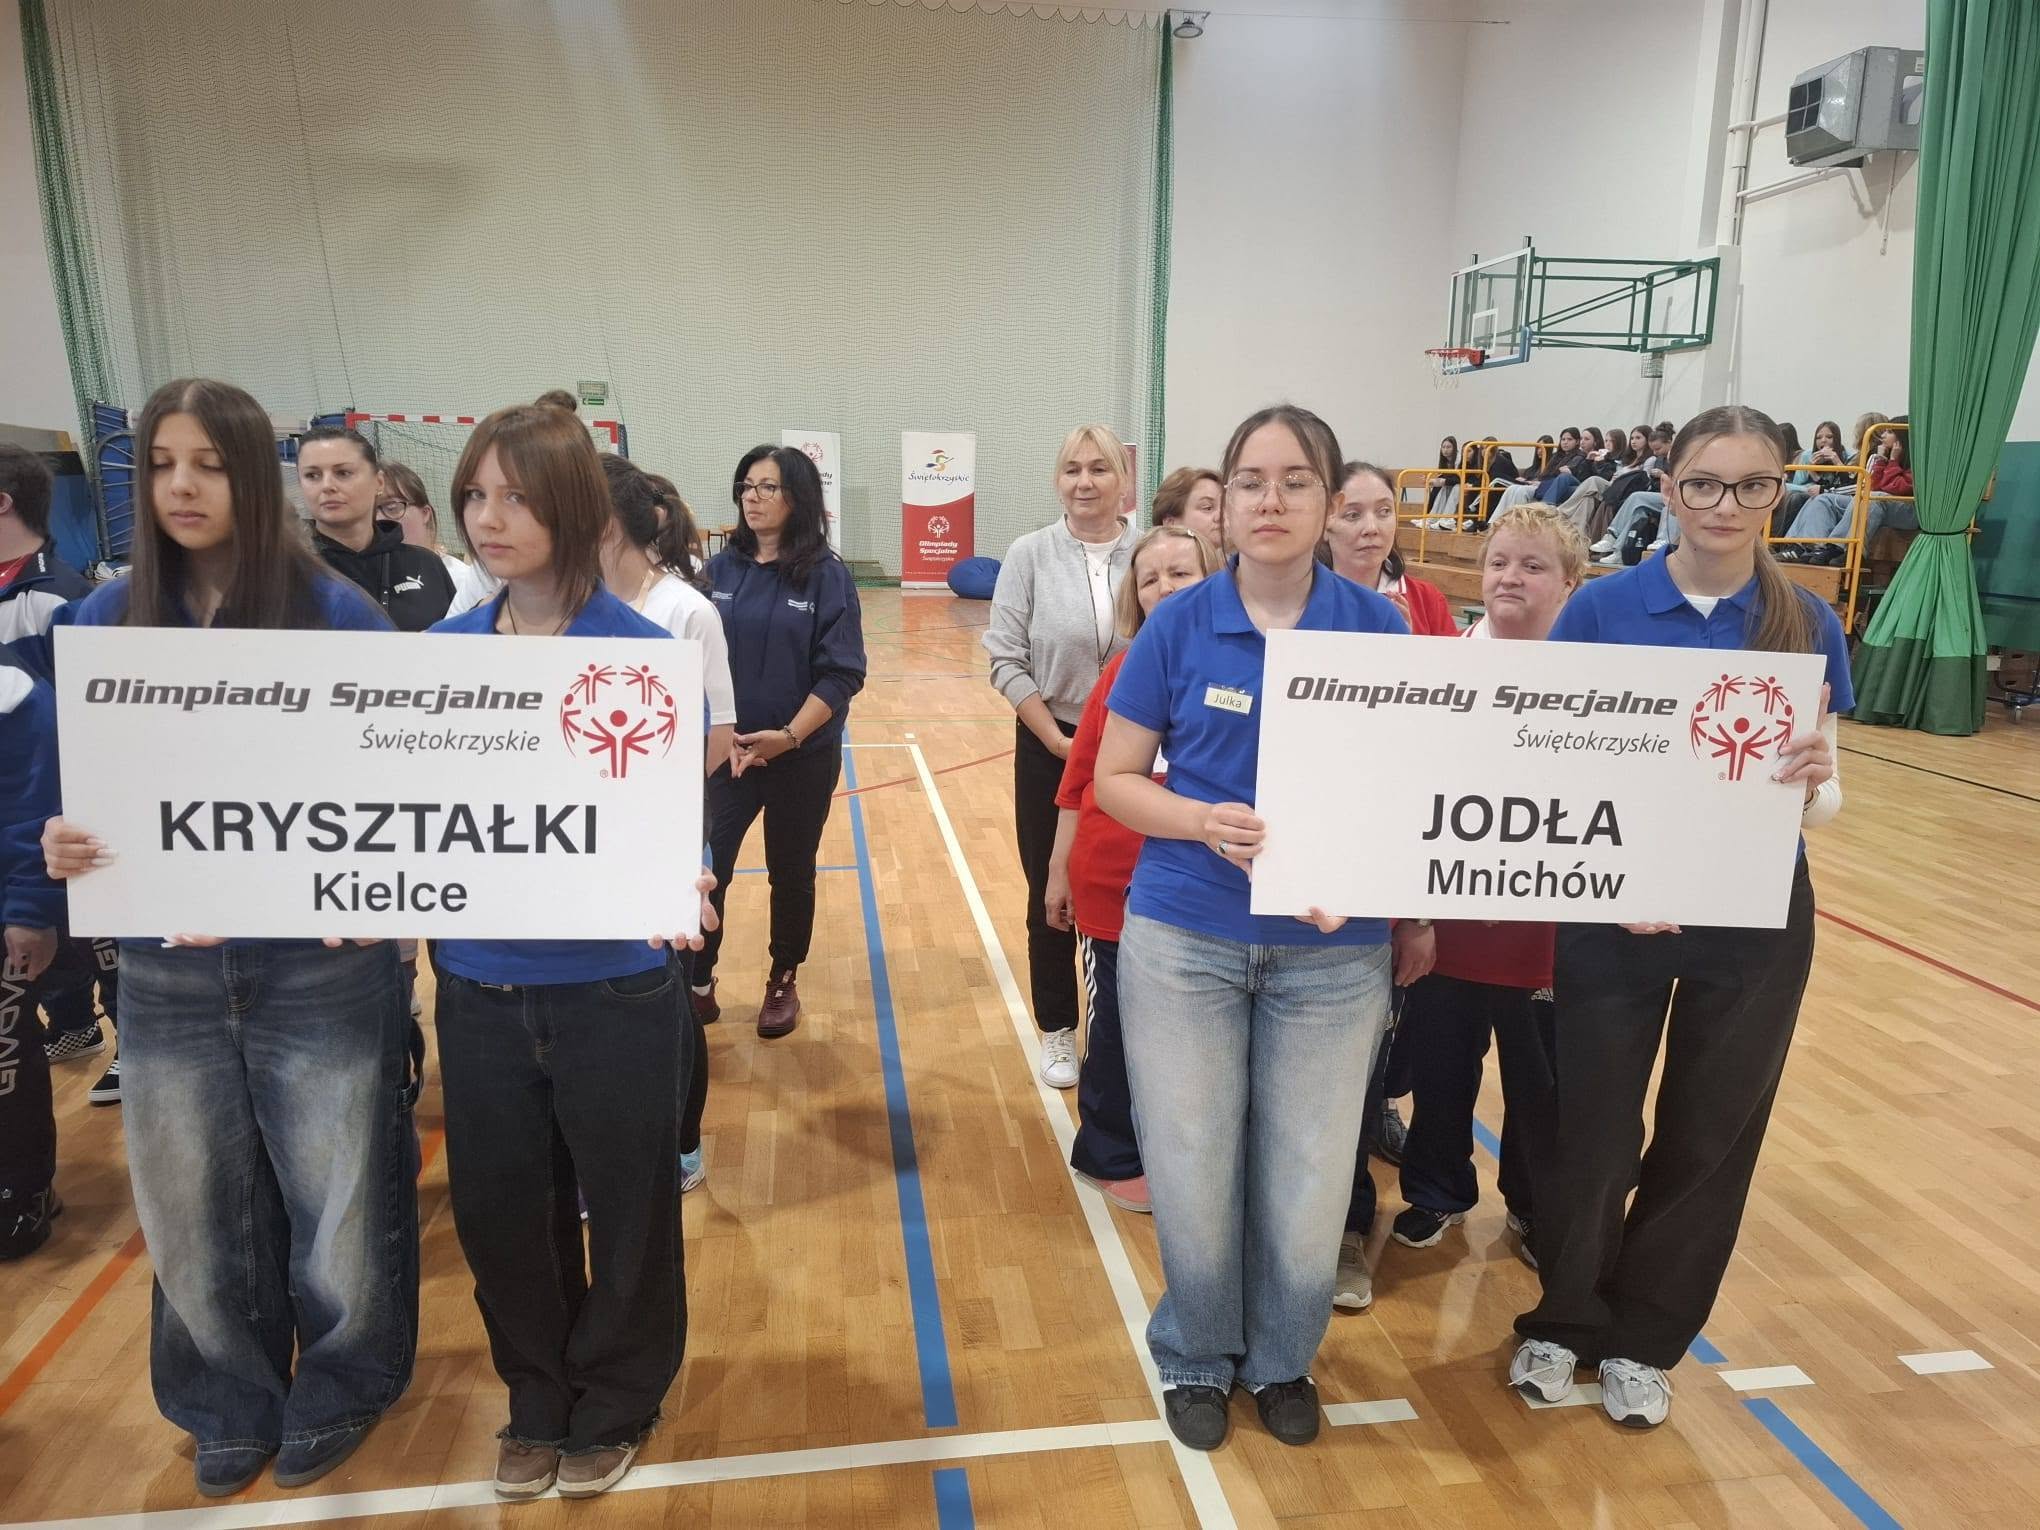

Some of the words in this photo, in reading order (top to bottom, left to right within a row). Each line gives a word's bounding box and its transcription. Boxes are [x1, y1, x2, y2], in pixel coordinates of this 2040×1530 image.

[918, 540, 958, 548] Olimpiady
[85, 678, 311, 713] Olimpiady
[330, 682, 543, 715] Specjalne
[1213, 693, 1242, 708] Julka
[1287, 676, 1478, 713] Olimpiady
[1492, 685, 1678, 718] Specjalne
[359, 723, 540, 755] Świętokrzyskie
[1513, 723, 1670, 756] Świętokrzyskie
[160, 800, 597, 854] KRYSZTAŁKI
[1422, 794, 1623, 847] JODŁA
[314, 870, 467, 913] Kielce
[1427, 859, 1626, 900] Mnichów
